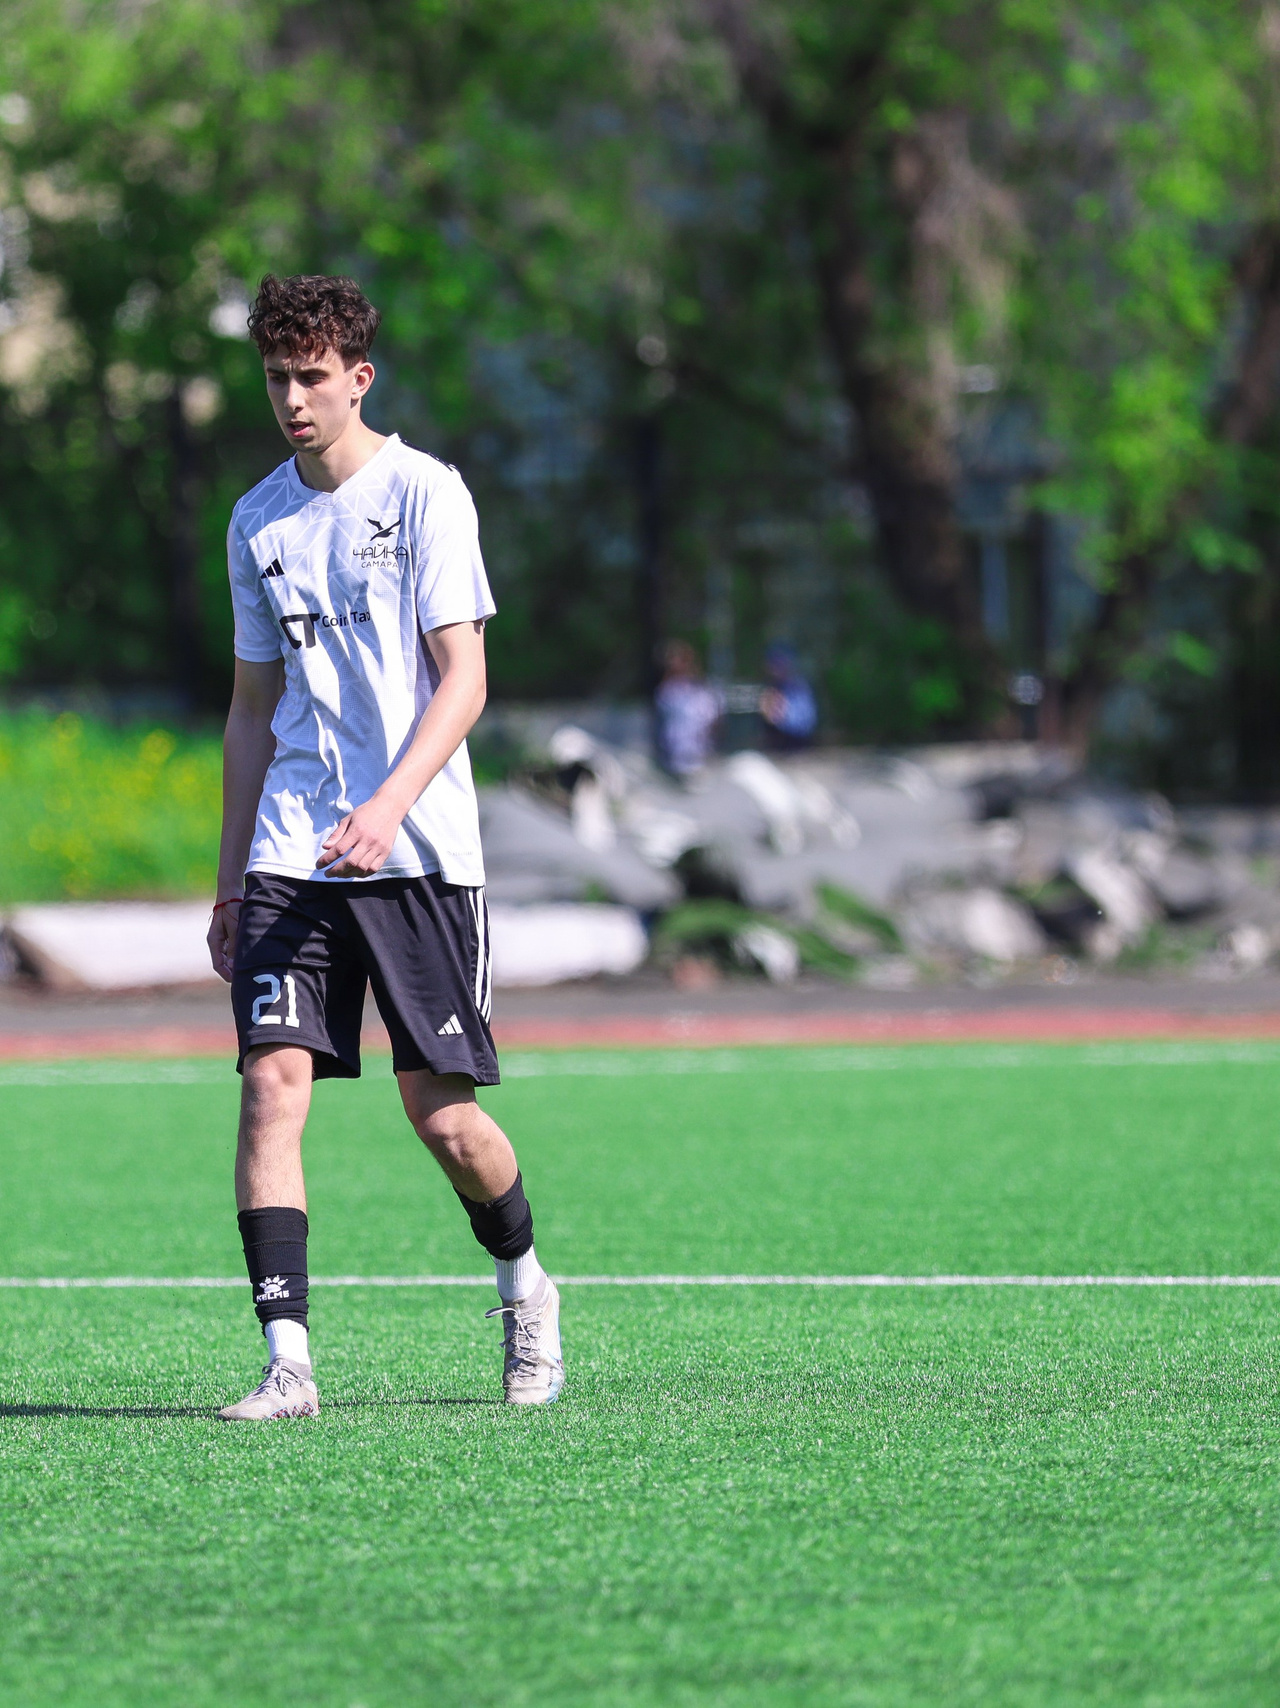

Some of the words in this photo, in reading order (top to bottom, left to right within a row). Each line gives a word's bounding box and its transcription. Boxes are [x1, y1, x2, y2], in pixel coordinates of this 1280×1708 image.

[352, 543, 408, 560] ЧАЙКА
[361, 560, 399, 569] САМАРА
[251, 973, 300, 1028] 21
[256, 1289, 290, 1303] KELME
